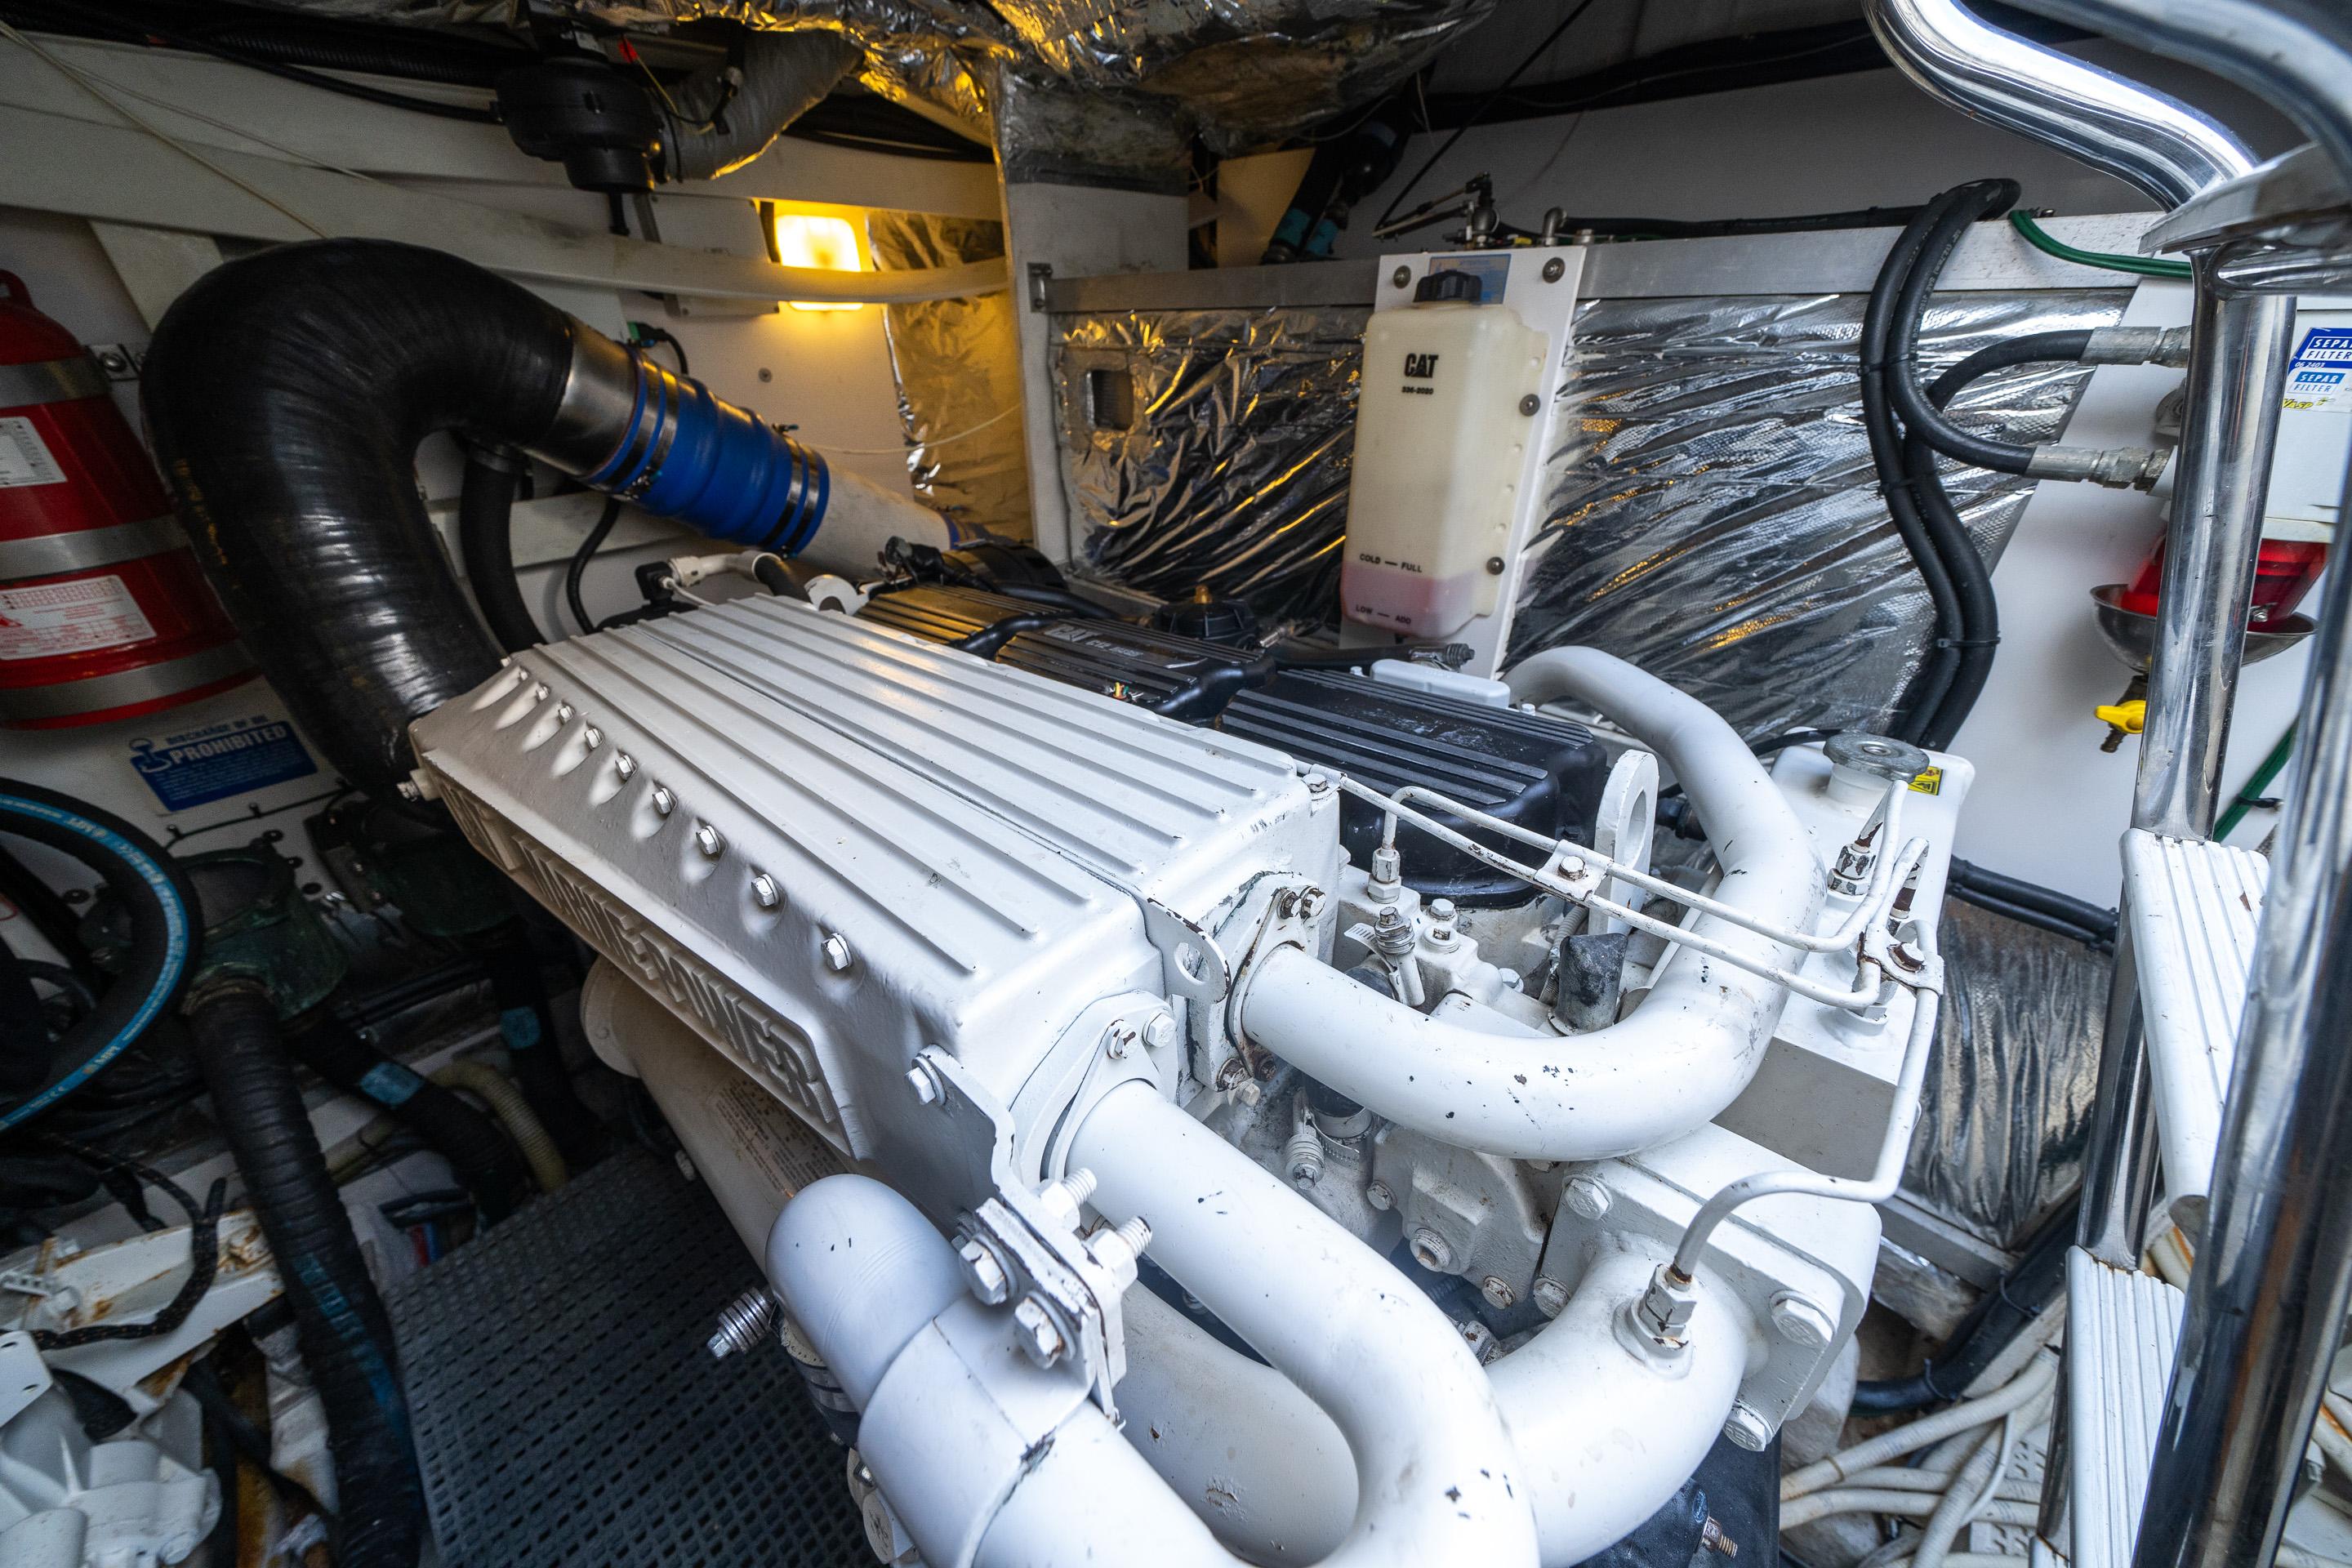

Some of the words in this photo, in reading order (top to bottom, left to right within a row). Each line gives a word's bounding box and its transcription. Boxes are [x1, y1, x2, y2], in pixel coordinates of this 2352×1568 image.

[2306, 350, 2352, 359] FILTER
[1404, 352, 1439, 378] CAT
[2294, 384, 2332, 392] FILTER
[2300, 373, 2339, 383] SEPAR
[1359, 554, 1381, 564] COLD
[1401, 562, 1423, 572] FULL
[1356, 604, 1373, 614] LOW
[1395, 615, 1412, 625] ADD
[1044, 623, 1102, 643] CAT
[169, 724, 287, 765] PROHIBITED
[640, 929, 833, 1124] POWER
